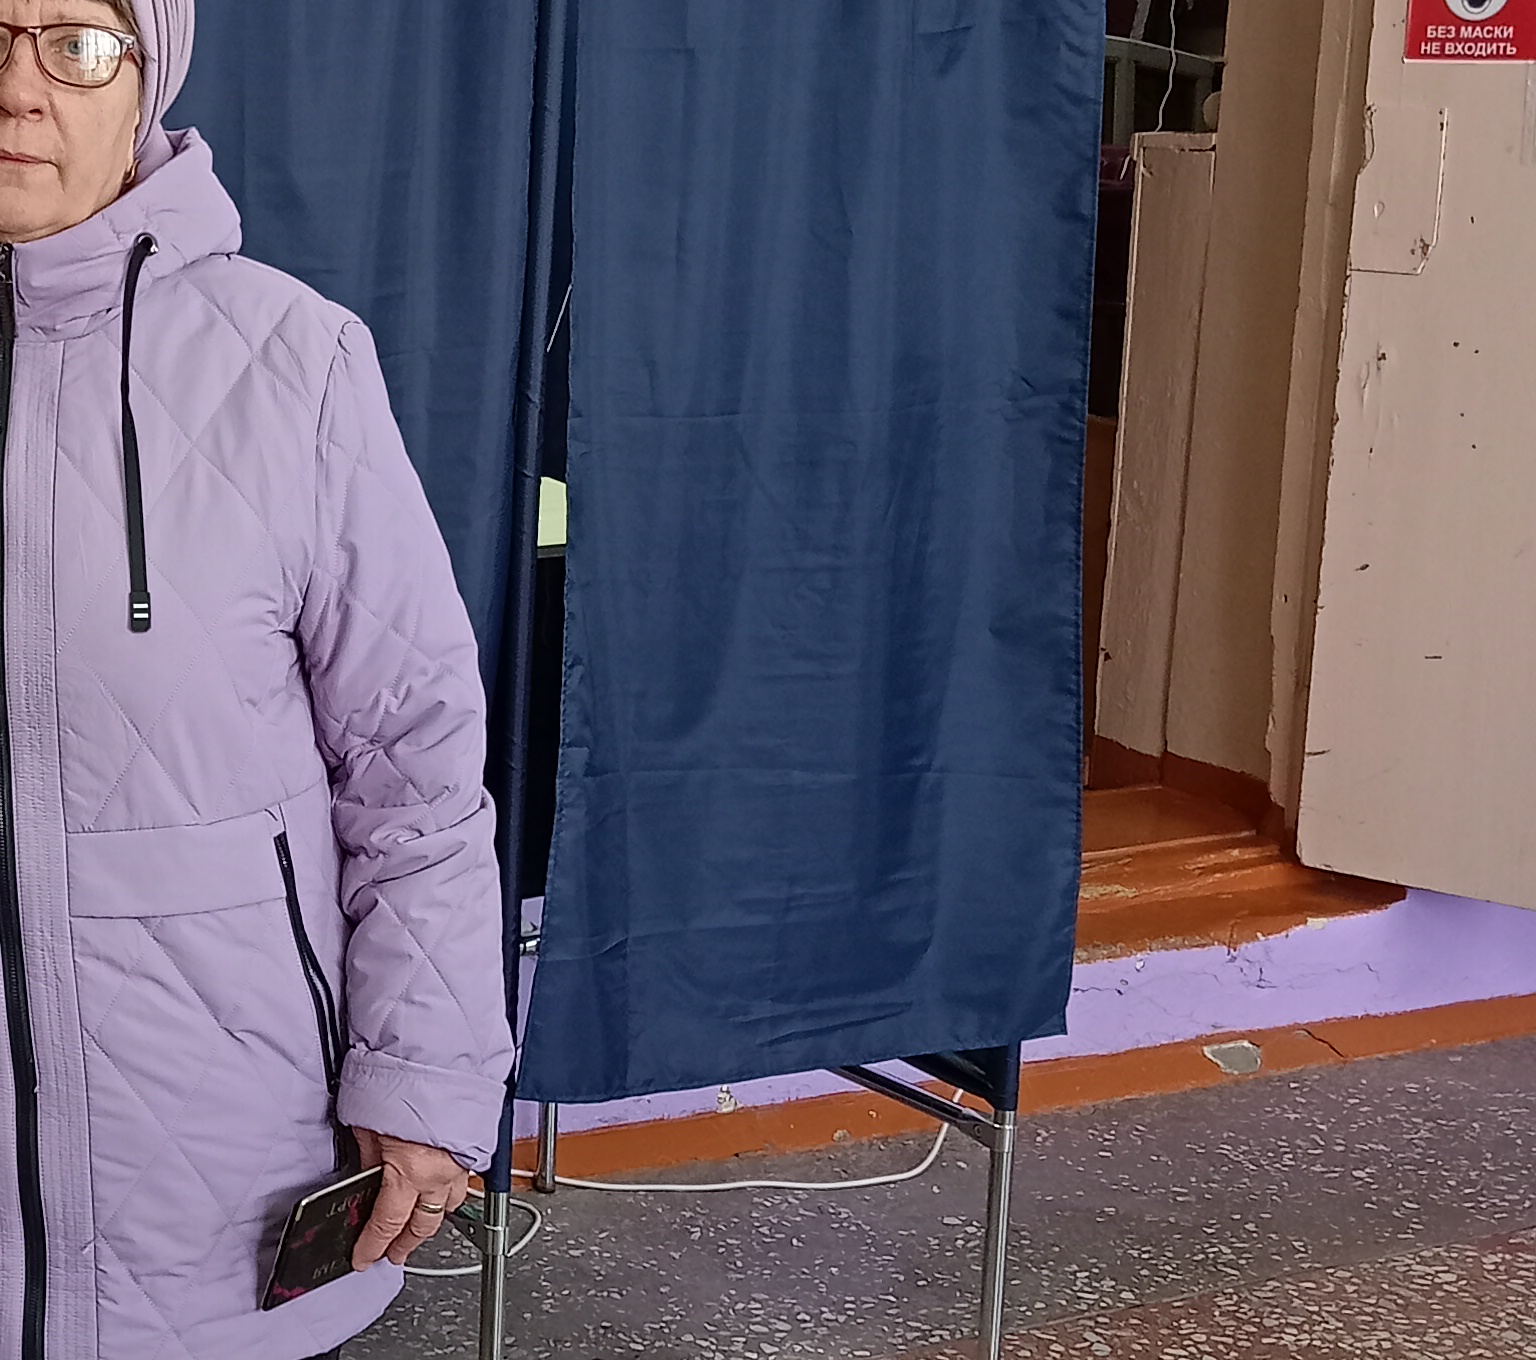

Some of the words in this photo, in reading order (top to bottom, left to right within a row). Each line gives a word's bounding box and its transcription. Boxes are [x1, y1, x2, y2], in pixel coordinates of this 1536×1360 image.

[1426, 25, 1456, 39] БЕЗ
[1459, 25, 1514, 39] МАСКИ
[1420, 42, 1441, 55] НЕ
[1444, 42, 1517, 57] ВХОДИТЬ
